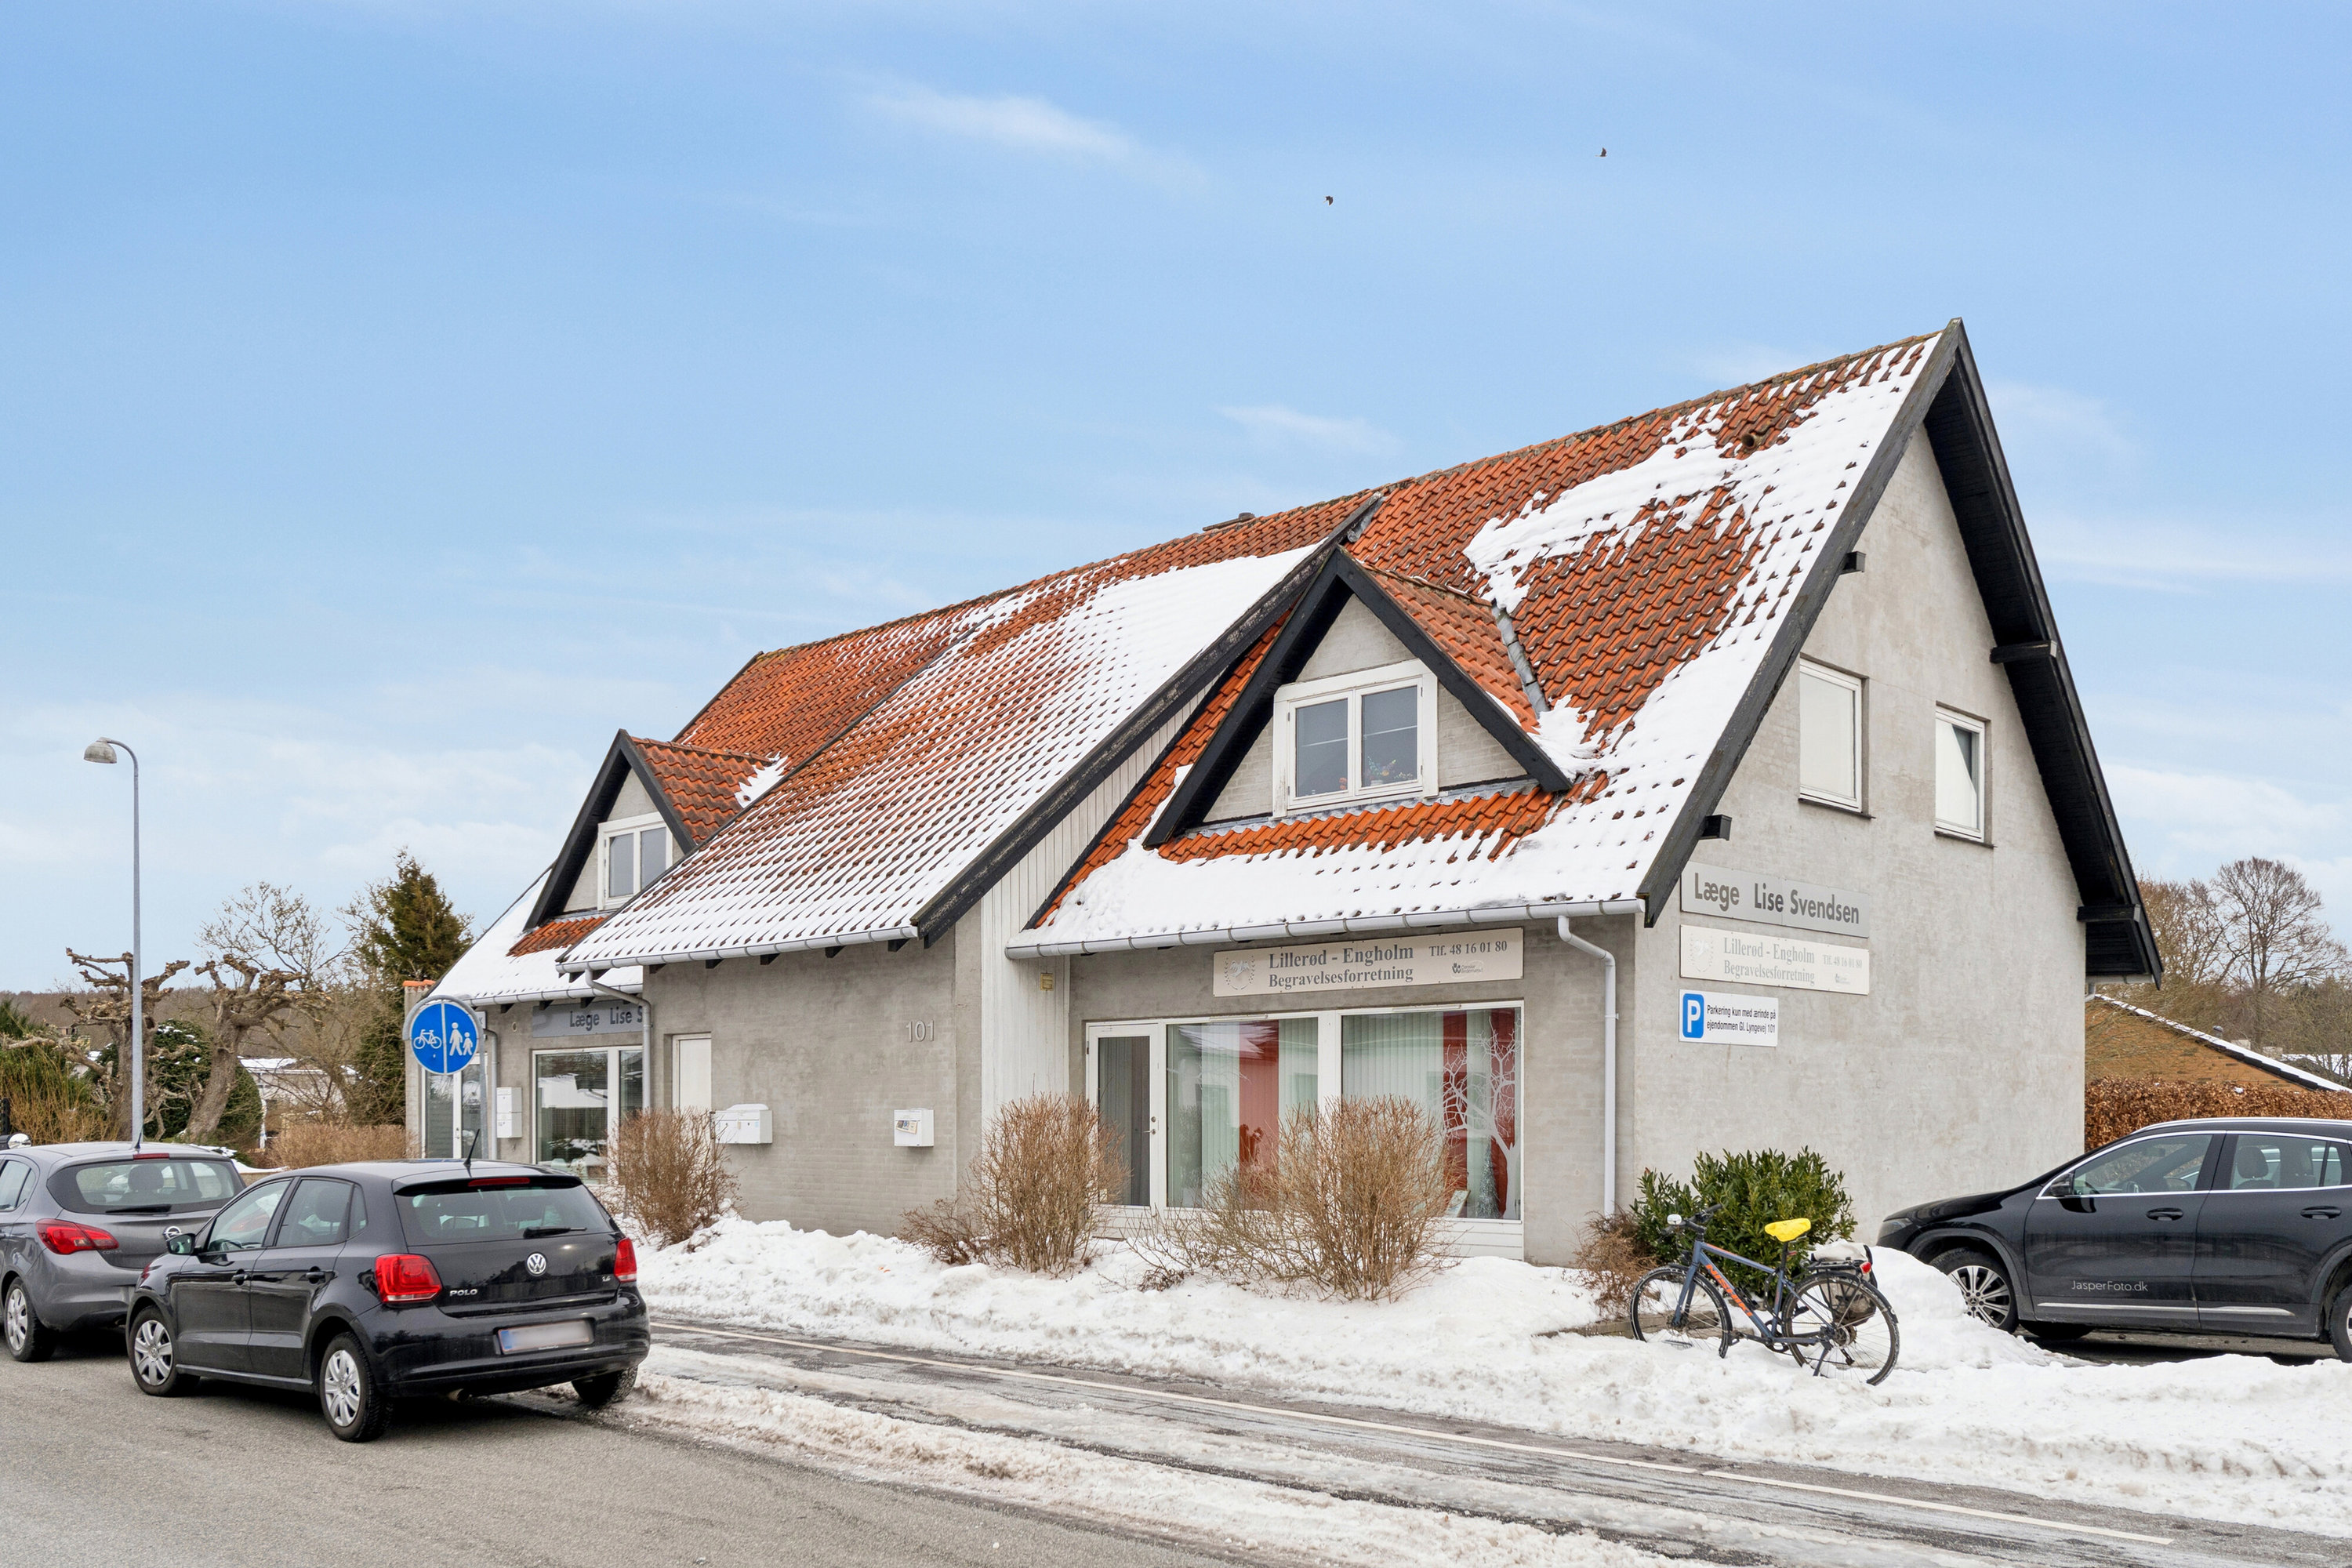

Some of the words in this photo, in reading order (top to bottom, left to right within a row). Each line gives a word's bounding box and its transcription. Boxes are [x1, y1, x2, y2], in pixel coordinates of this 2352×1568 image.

[1694, 872, 1740, 912] Læge
[1755, 882, 1784, 913] Lise
[1790, 888, 1860, 924] Svendsen
[1269, 949, 1327, 969] Lillerød
[1342, 944, 1414, 967] Engholm
[1428, 945, 1446, 956] Tlf.
[1450, 943, 1461, 955] 48
[1465, 942, 1477, 954] 16
[1479, 942, 1490, 953] 01
[1494, 940, 1508, 952] 80
[1773, 943, 1815, 965] Engholm
[1269, 966, 1414, 990] Begravelsesforretning
[1724, 959, 1815, 986] Begravelsesforretning
[570, 1010, 600, 1032] Læge
[610, 1006, 633, 1025] Lise
[1707, 1004, 1731, 1018] Parkering
[1732, 1007, 1741, 1017] kun
[1742, 1008, 1753, 1018] med
[905, 1019, 935, 1043] 101
[1707, 1019, 1738, 1031] ejendommen
[1746, 1022, 1766, 1035] Lyngevej
[1767, 1024, 1776, 1033] 101
[449, 1288, 477, 1297] POLO
[2071, 1279, 2149, 1292] JasperFoto.dk
